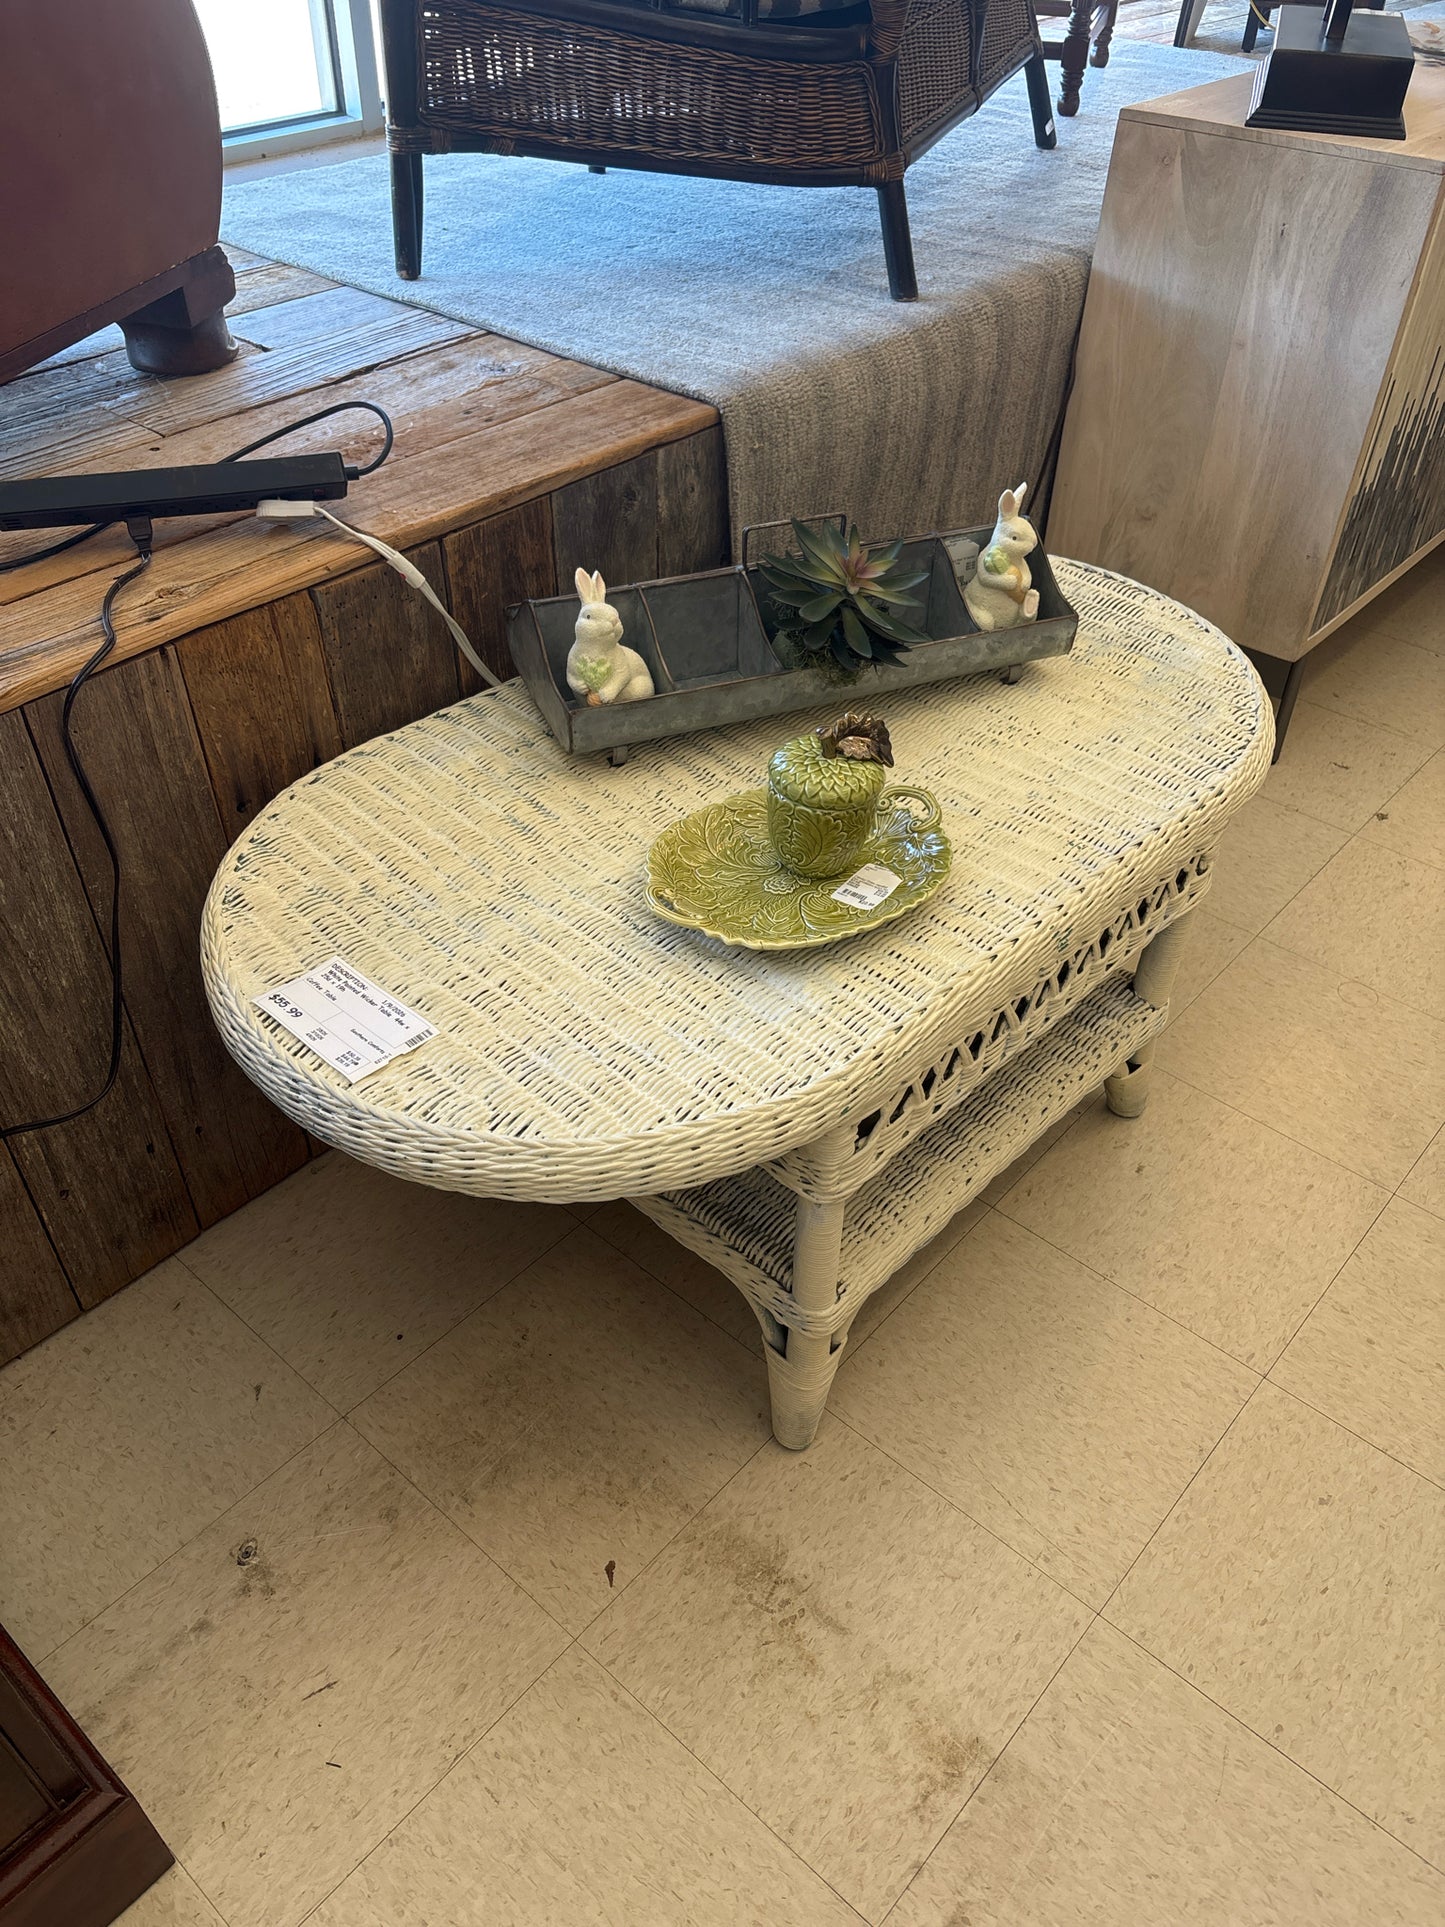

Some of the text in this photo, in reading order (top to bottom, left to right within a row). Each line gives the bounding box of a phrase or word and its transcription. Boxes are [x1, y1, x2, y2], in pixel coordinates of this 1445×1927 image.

[306, 977, 337, 1001] Coffee Table
[331, 963, 368, 990] DESCRIPTION:
[268, 993, 303, 1017] $55.99
[327, 969, 342, 982] White
[341, 980, 362, 995] Painted
[360, 993, 378, 1006] Wicker
[378, 1005, 392, 1017] Table
